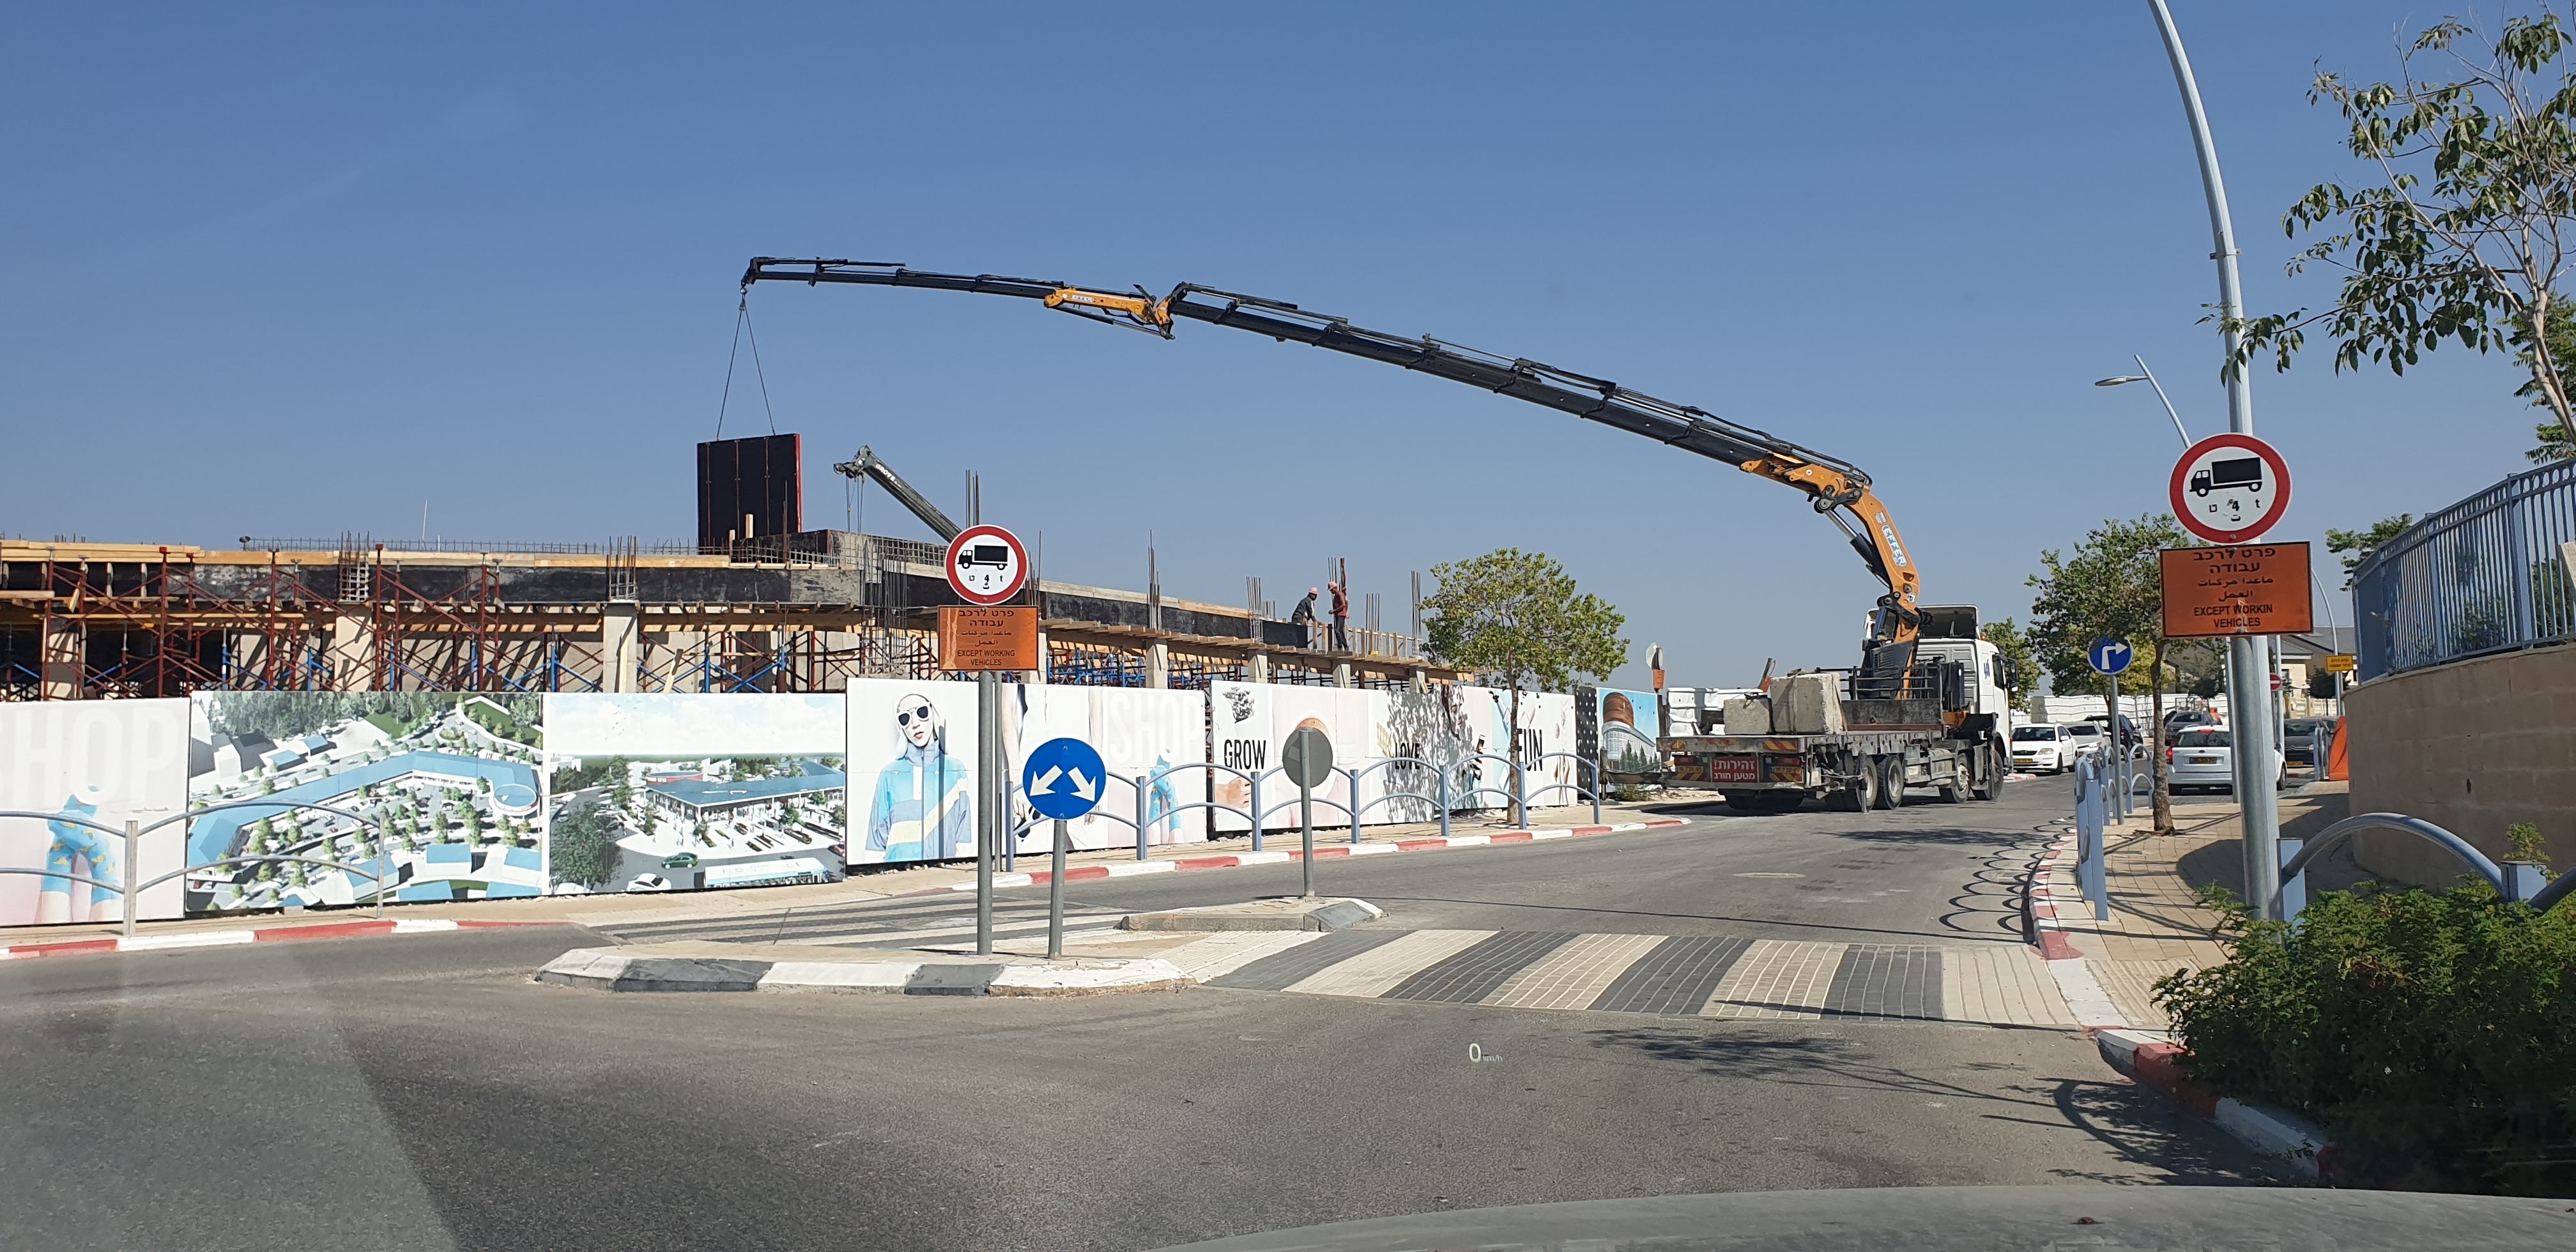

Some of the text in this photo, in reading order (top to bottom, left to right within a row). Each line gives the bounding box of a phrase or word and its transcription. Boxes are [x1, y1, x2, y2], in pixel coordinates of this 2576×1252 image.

[875, 463, 896, 482] GROVE
[2232, 500, 2239, 511] 4
[2255, 499, 2260, 508] t
[2193, 547, 2276, 561] פרט לרכב
[2209, 562, 2260, 574] עבודה
[985, 574, 990, 583] 4
[2218, 590, 2253, 602] العمل
[959, 608, 987, 617] לרכב
[2194, 604, 2273, 616] EXCEPT WORKIN
[2214, 617, 2261, 628] VEHICLES
[1109, 692, 1202, 764] SHOP
[0, 706, 179, 807] HOP
[1223, 738, 1266, 770] GROW
[1395, 742, 1420, 770] LOVE
[1713, 760, 1756, 770] זהירות!
[1733, 772, 1756, 782] מטען
[1469, 1042, 1481, 1063] 0
